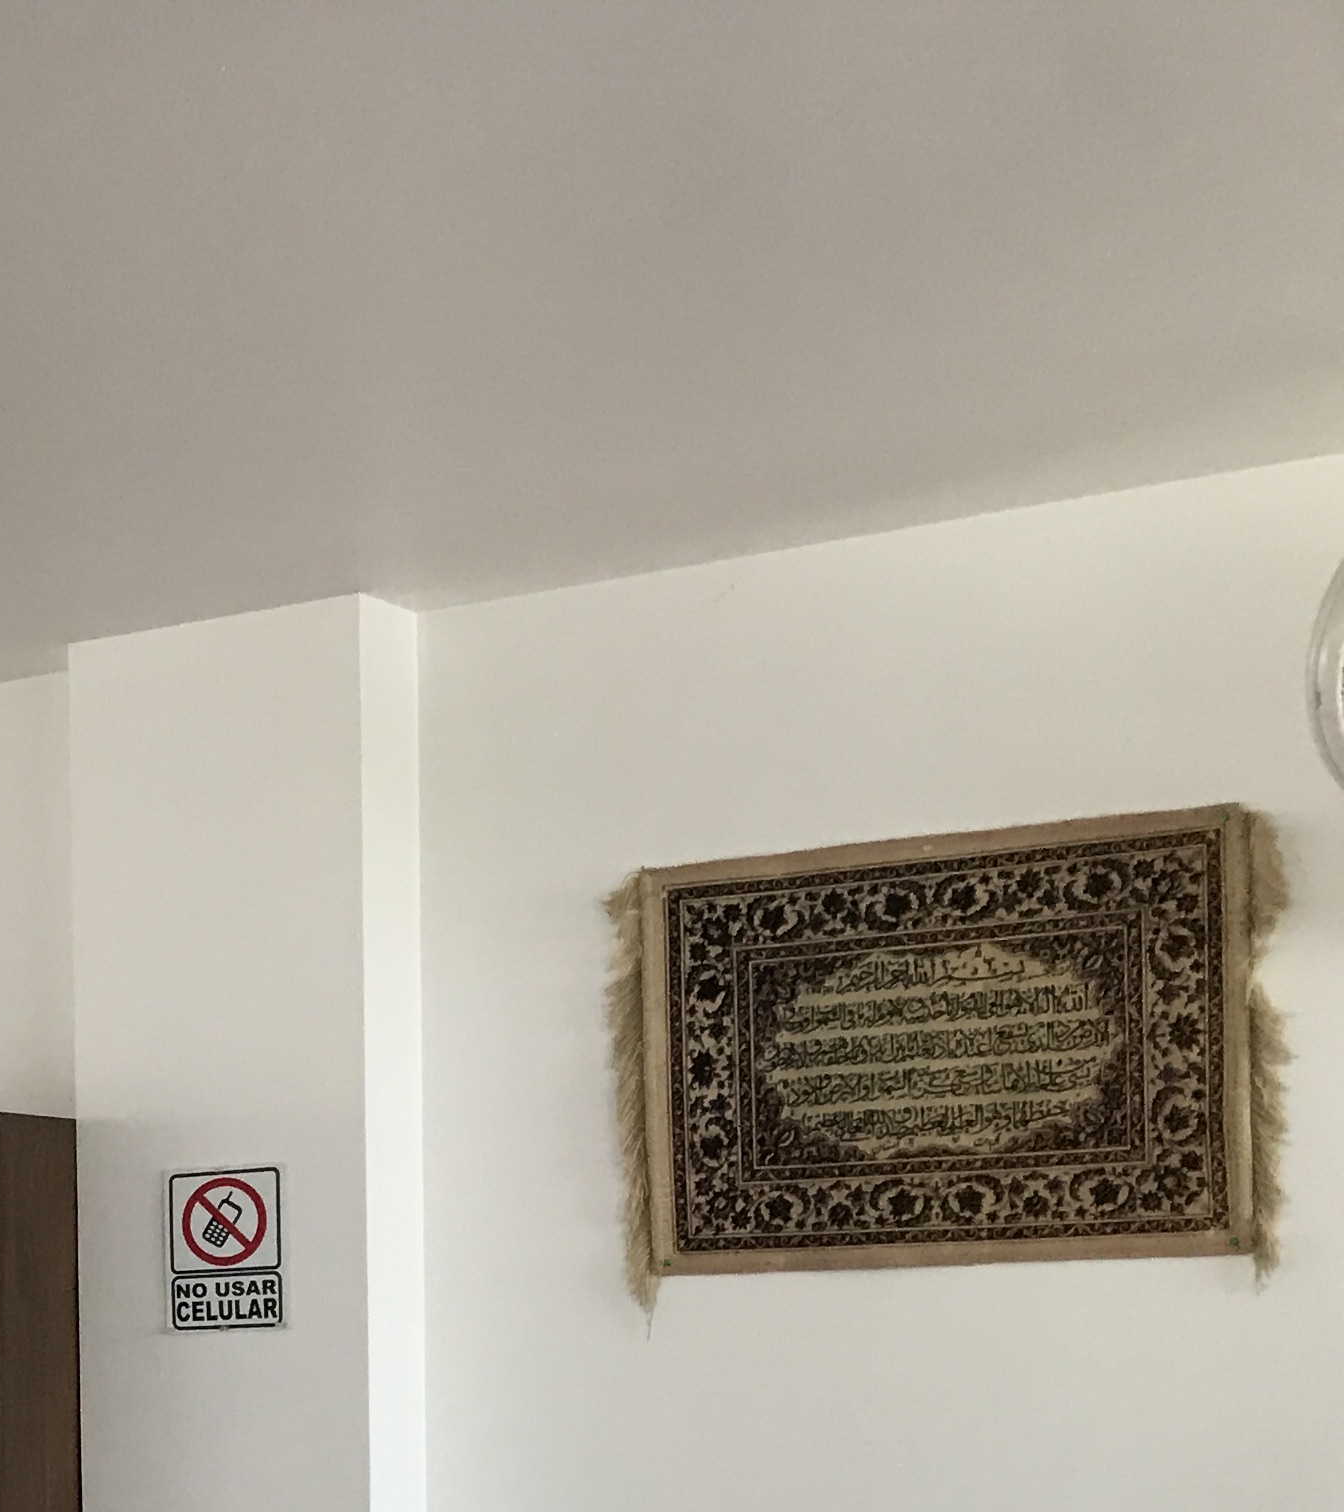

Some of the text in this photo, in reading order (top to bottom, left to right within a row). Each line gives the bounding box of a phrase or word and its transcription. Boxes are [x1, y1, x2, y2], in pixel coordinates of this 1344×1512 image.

[176, 1279, 278, 1299] NO USAR
[176, 1297, 278, 1322] CELULAR
